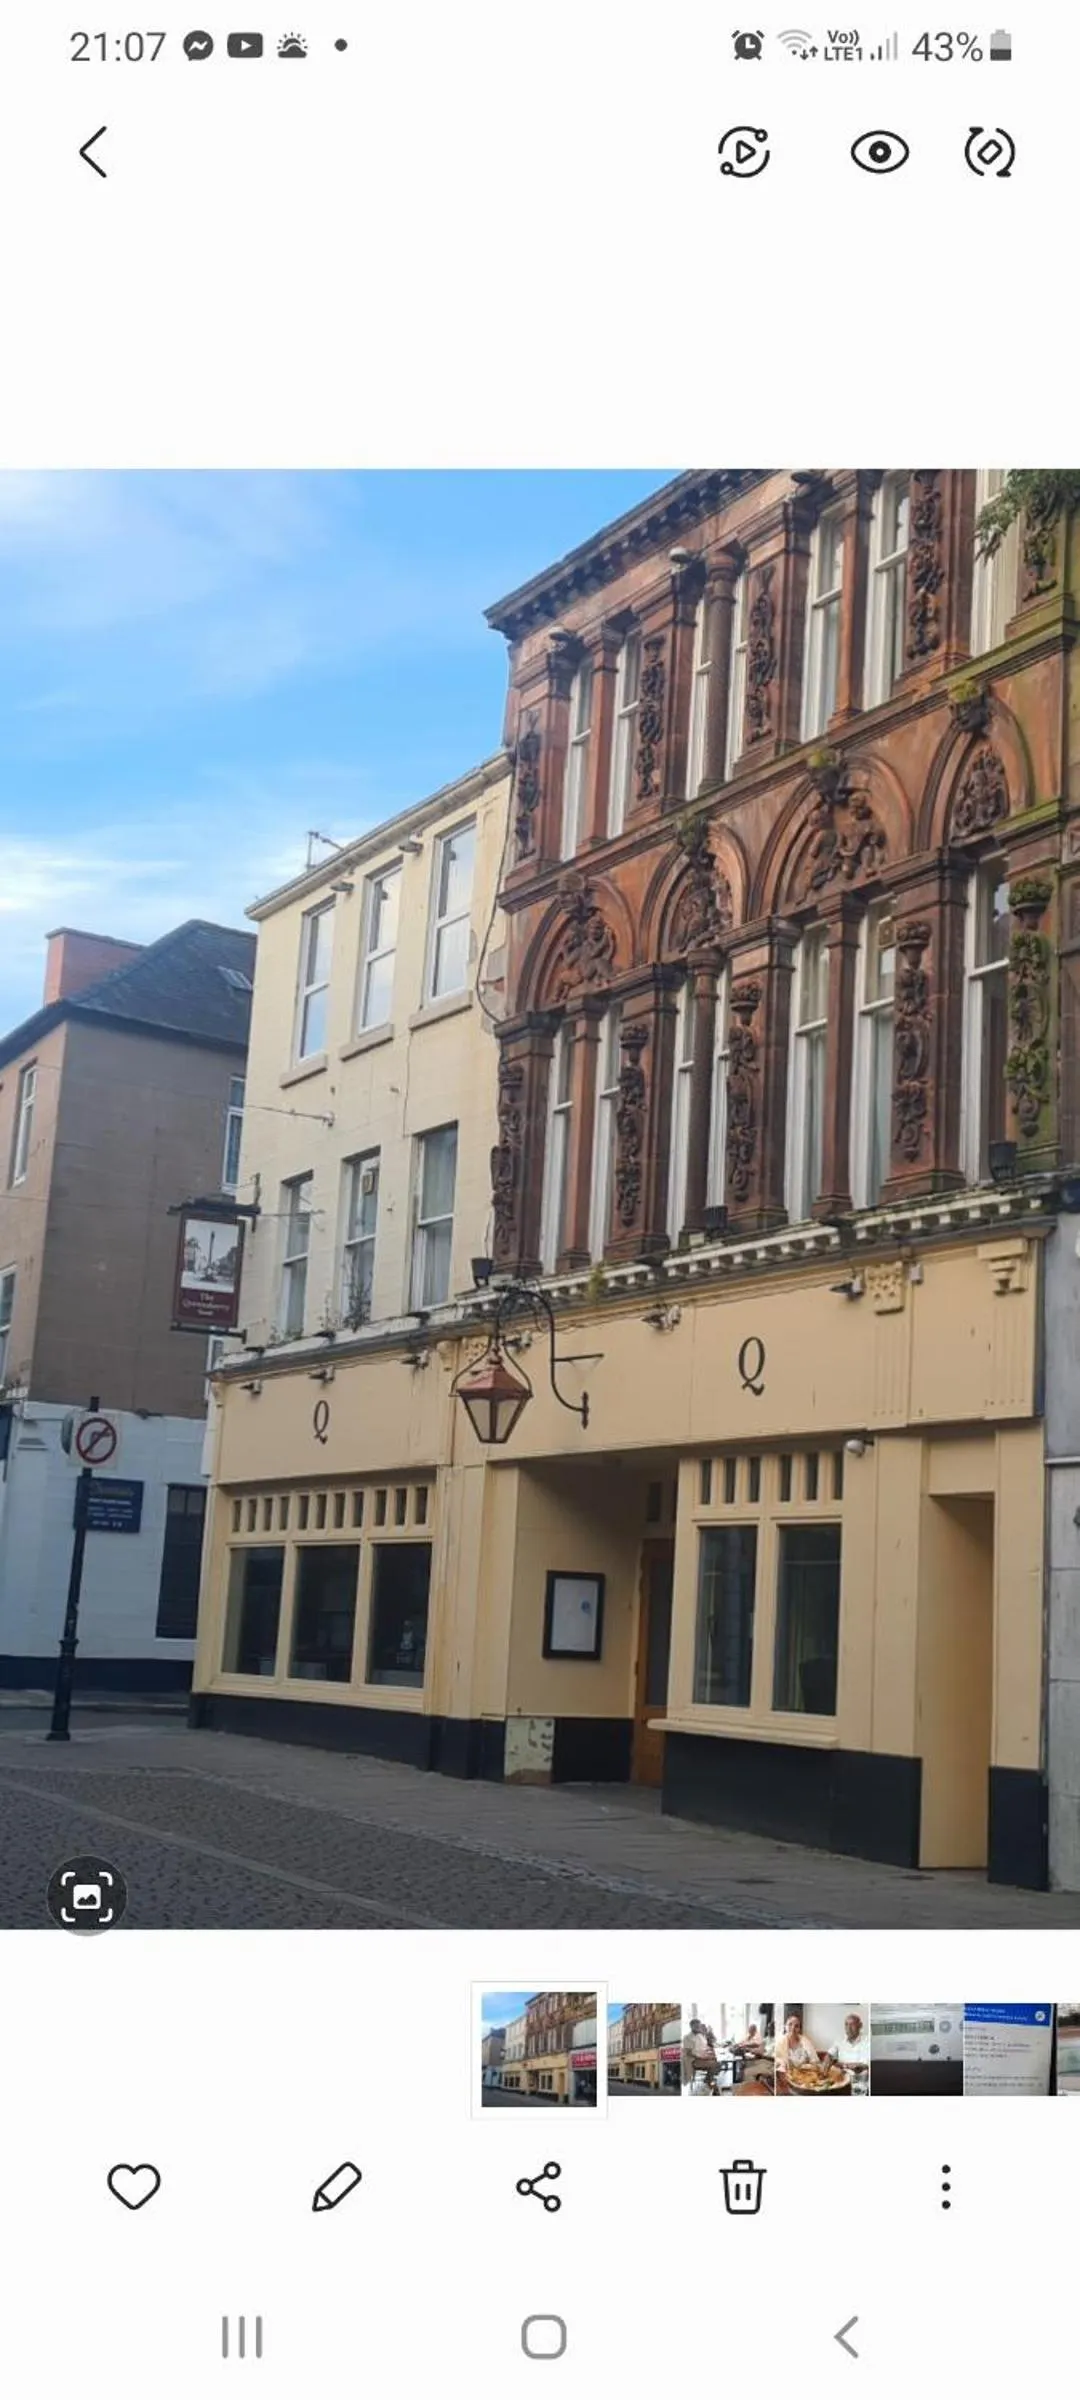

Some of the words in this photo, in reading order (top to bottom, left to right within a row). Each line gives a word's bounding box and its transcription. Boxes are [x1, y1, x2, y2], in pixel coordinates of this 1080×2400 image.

[70, 31, 167, 62] 21:07
[824, 46, 863, 62] LTE1
[911, 31, 984, 62] 43%
[738, 1336, 767, 1397] Q
[313, 1399, 330, 1445] Q
